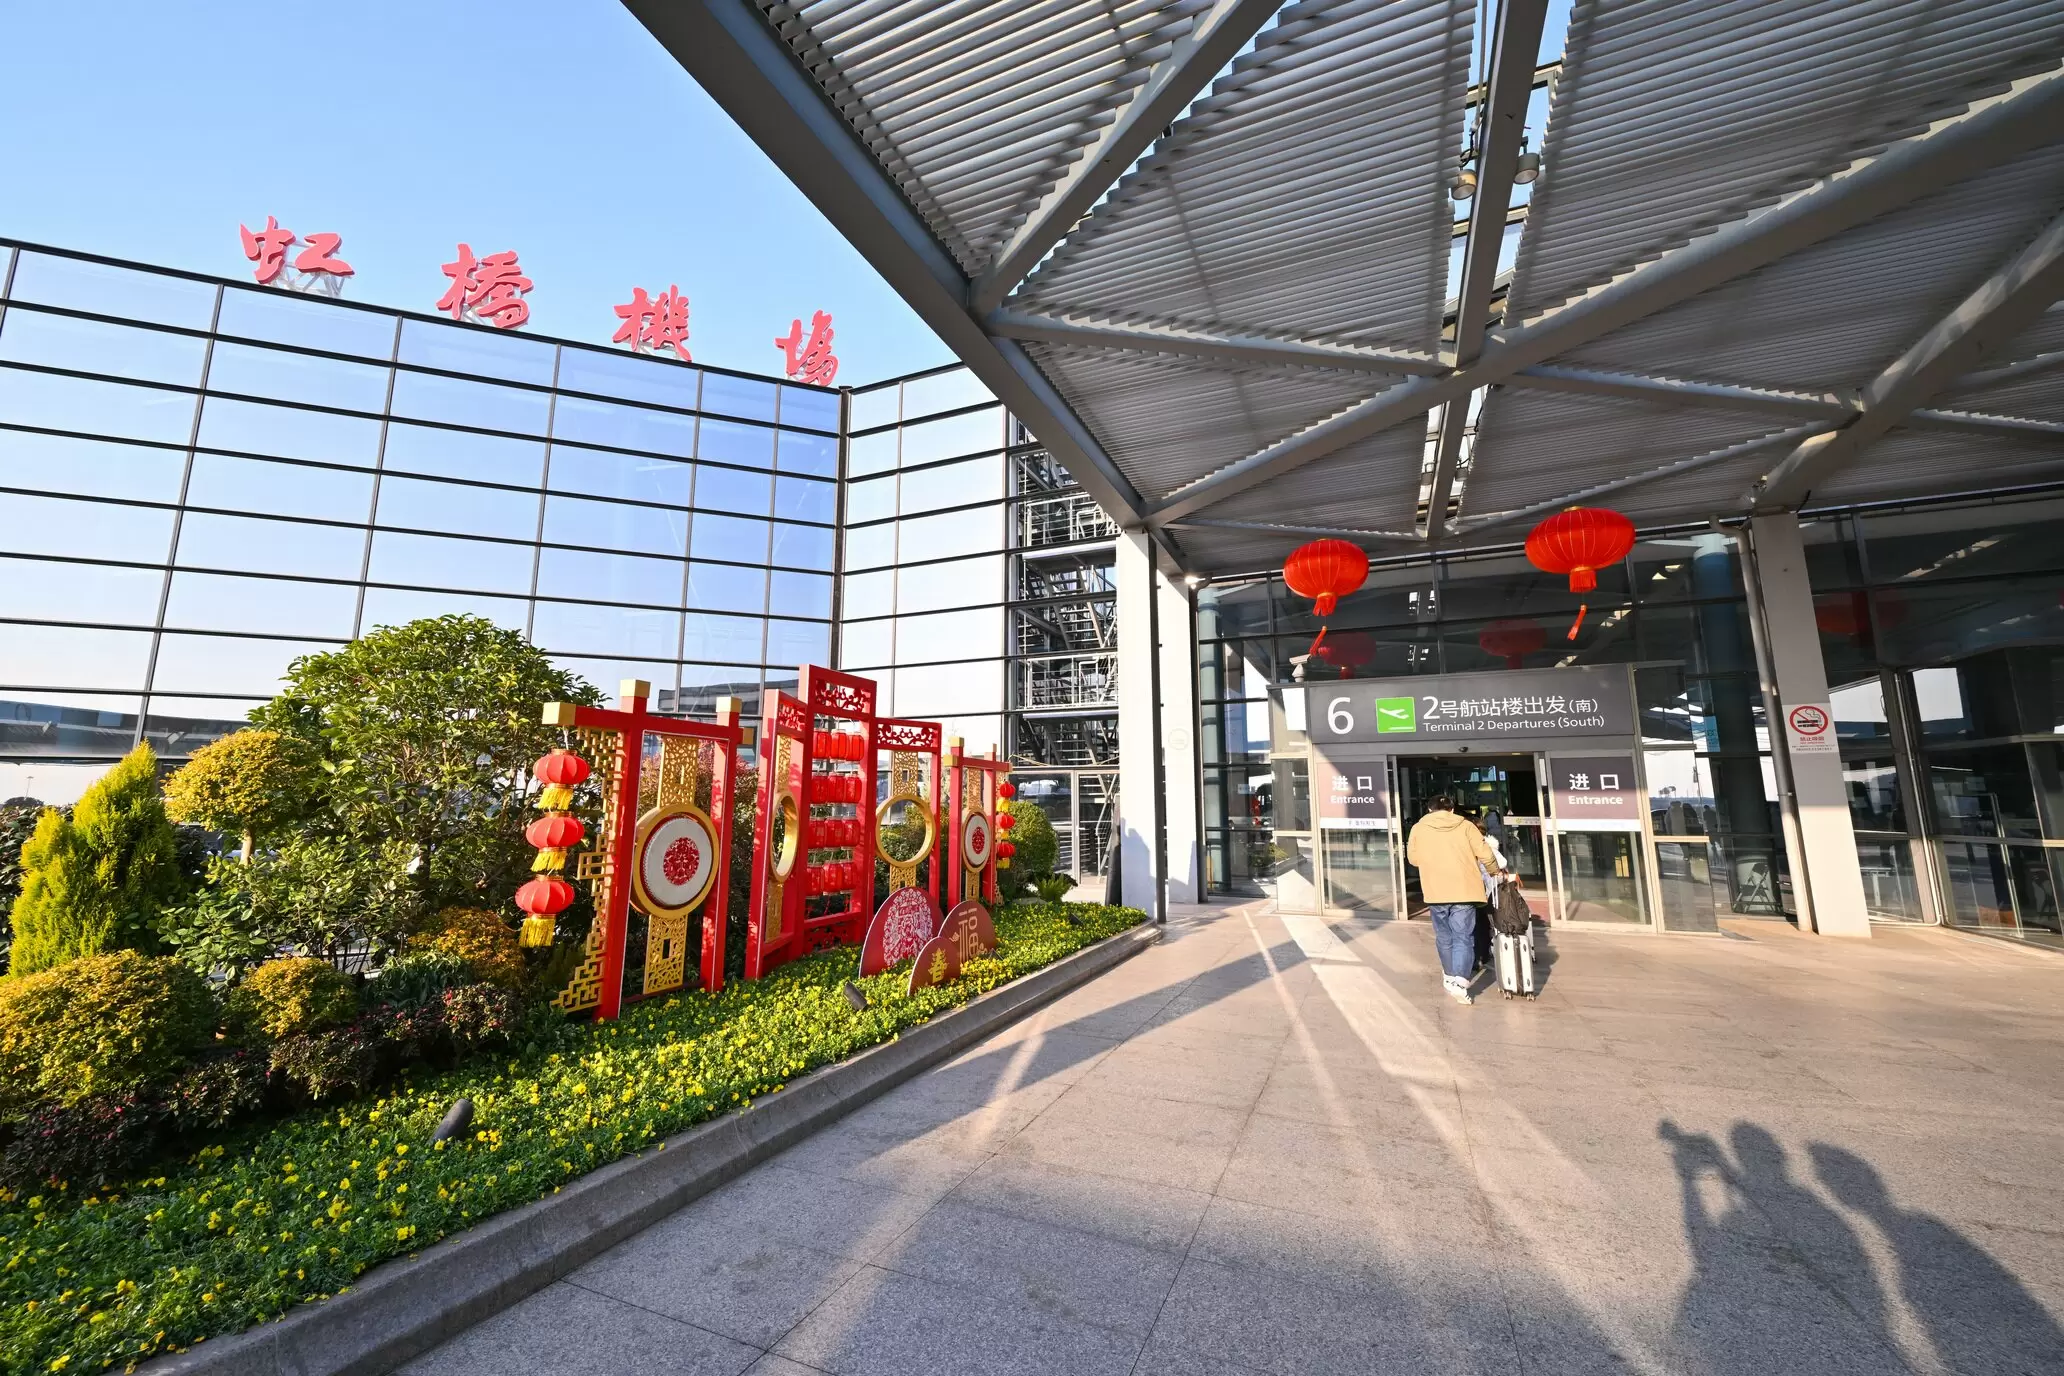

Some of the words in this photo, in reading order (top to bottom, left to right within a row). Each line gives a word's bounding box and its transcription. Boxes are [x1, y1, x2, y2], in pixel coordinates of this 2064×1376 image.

[1327, 697, 1354, 735] 6
[1423, 721, 1475, 733] Terminal
[1477, 720, 1485, 731] 2
[1487, 718, 1556, 731] Departures
[1557, 714, 1605, 728] (South)
[1332, 775, 1373, 791] 进口
[1569, 773, 1620, 790] 进口
[1331, 795, 1375, 804] Entrance
[1568, 795, 1623, 805] Entrance
[928, 947, 949, 983] 春
